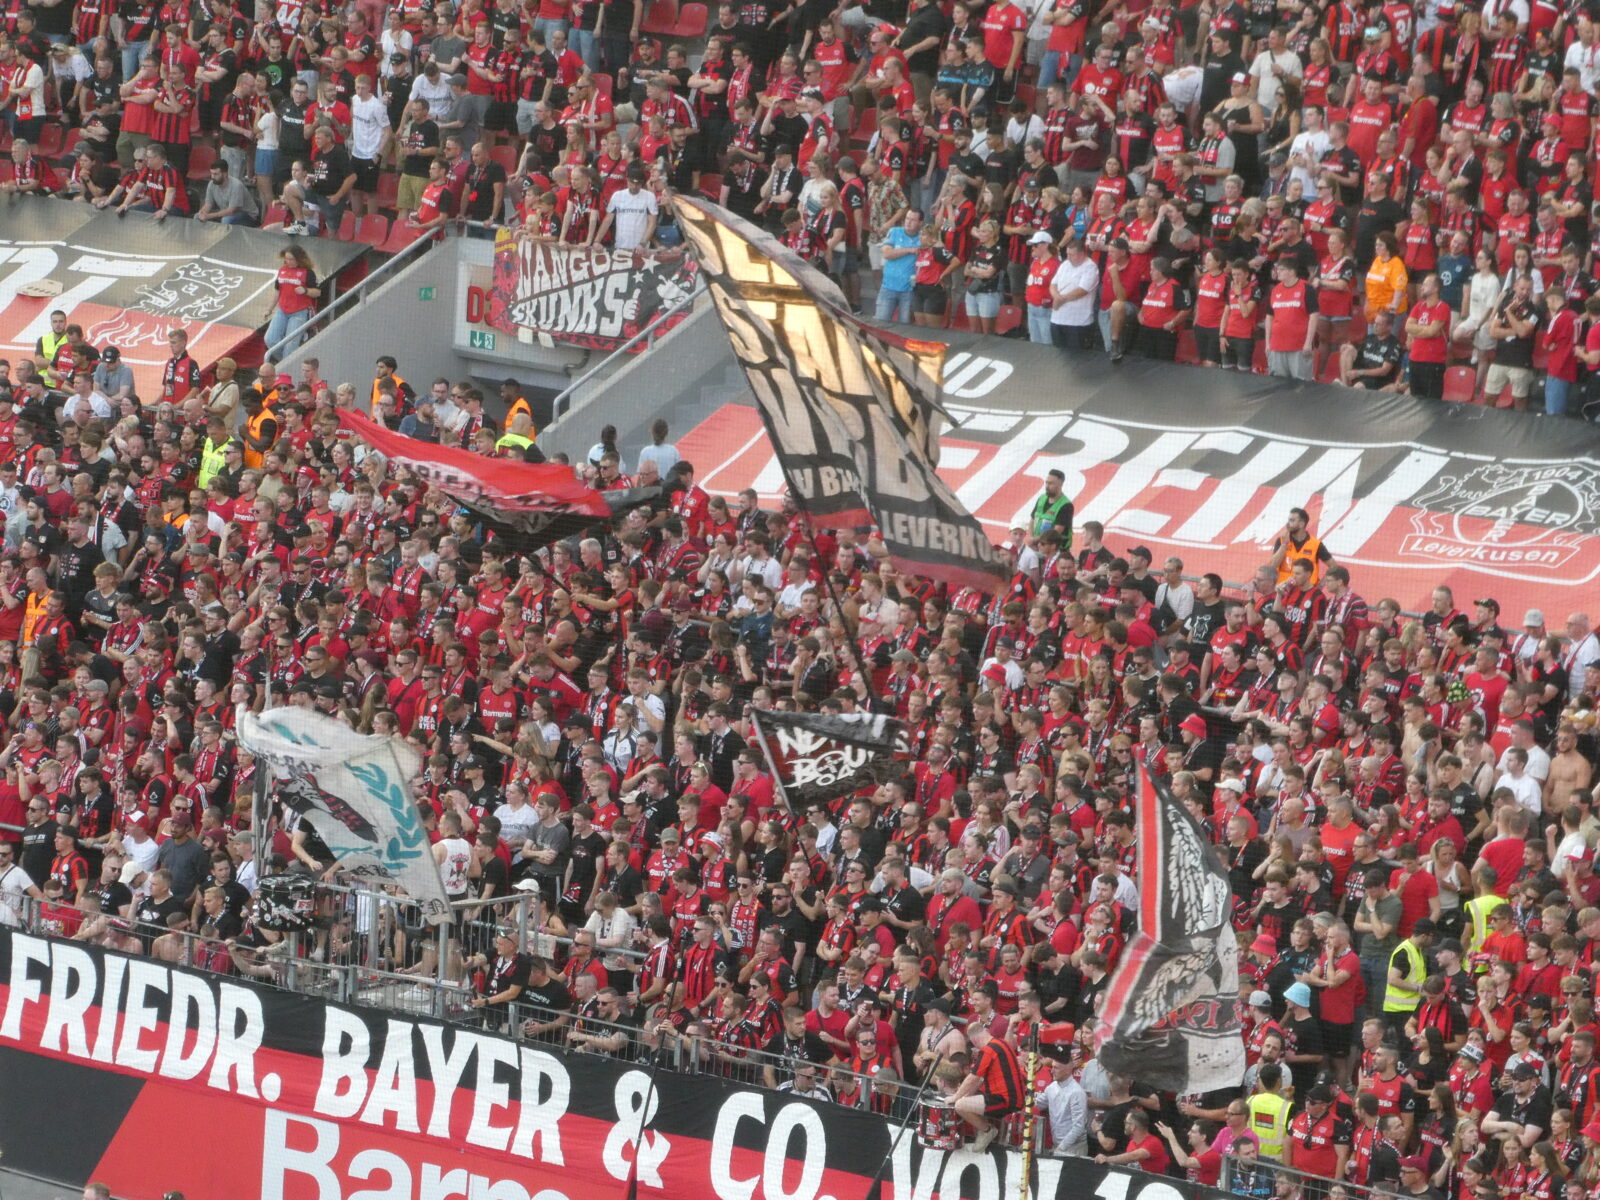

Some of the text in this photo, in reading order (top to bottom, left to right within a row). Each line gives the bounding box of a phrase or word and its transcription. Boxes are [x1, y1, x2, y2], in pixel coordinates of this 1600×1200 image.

[511, 272, 629, 337] SKUNKS
[1532, 466, 1583, 481] 1904
[1465, 504, 1571, 526] BAYER
[1410, 537, 1559, 563] Leverkusen
[0, 932, 282, 1102] FRIEDR.
[314, 1005, 571, 1167] BAYER
[602, 1069, 671, 1189] &
